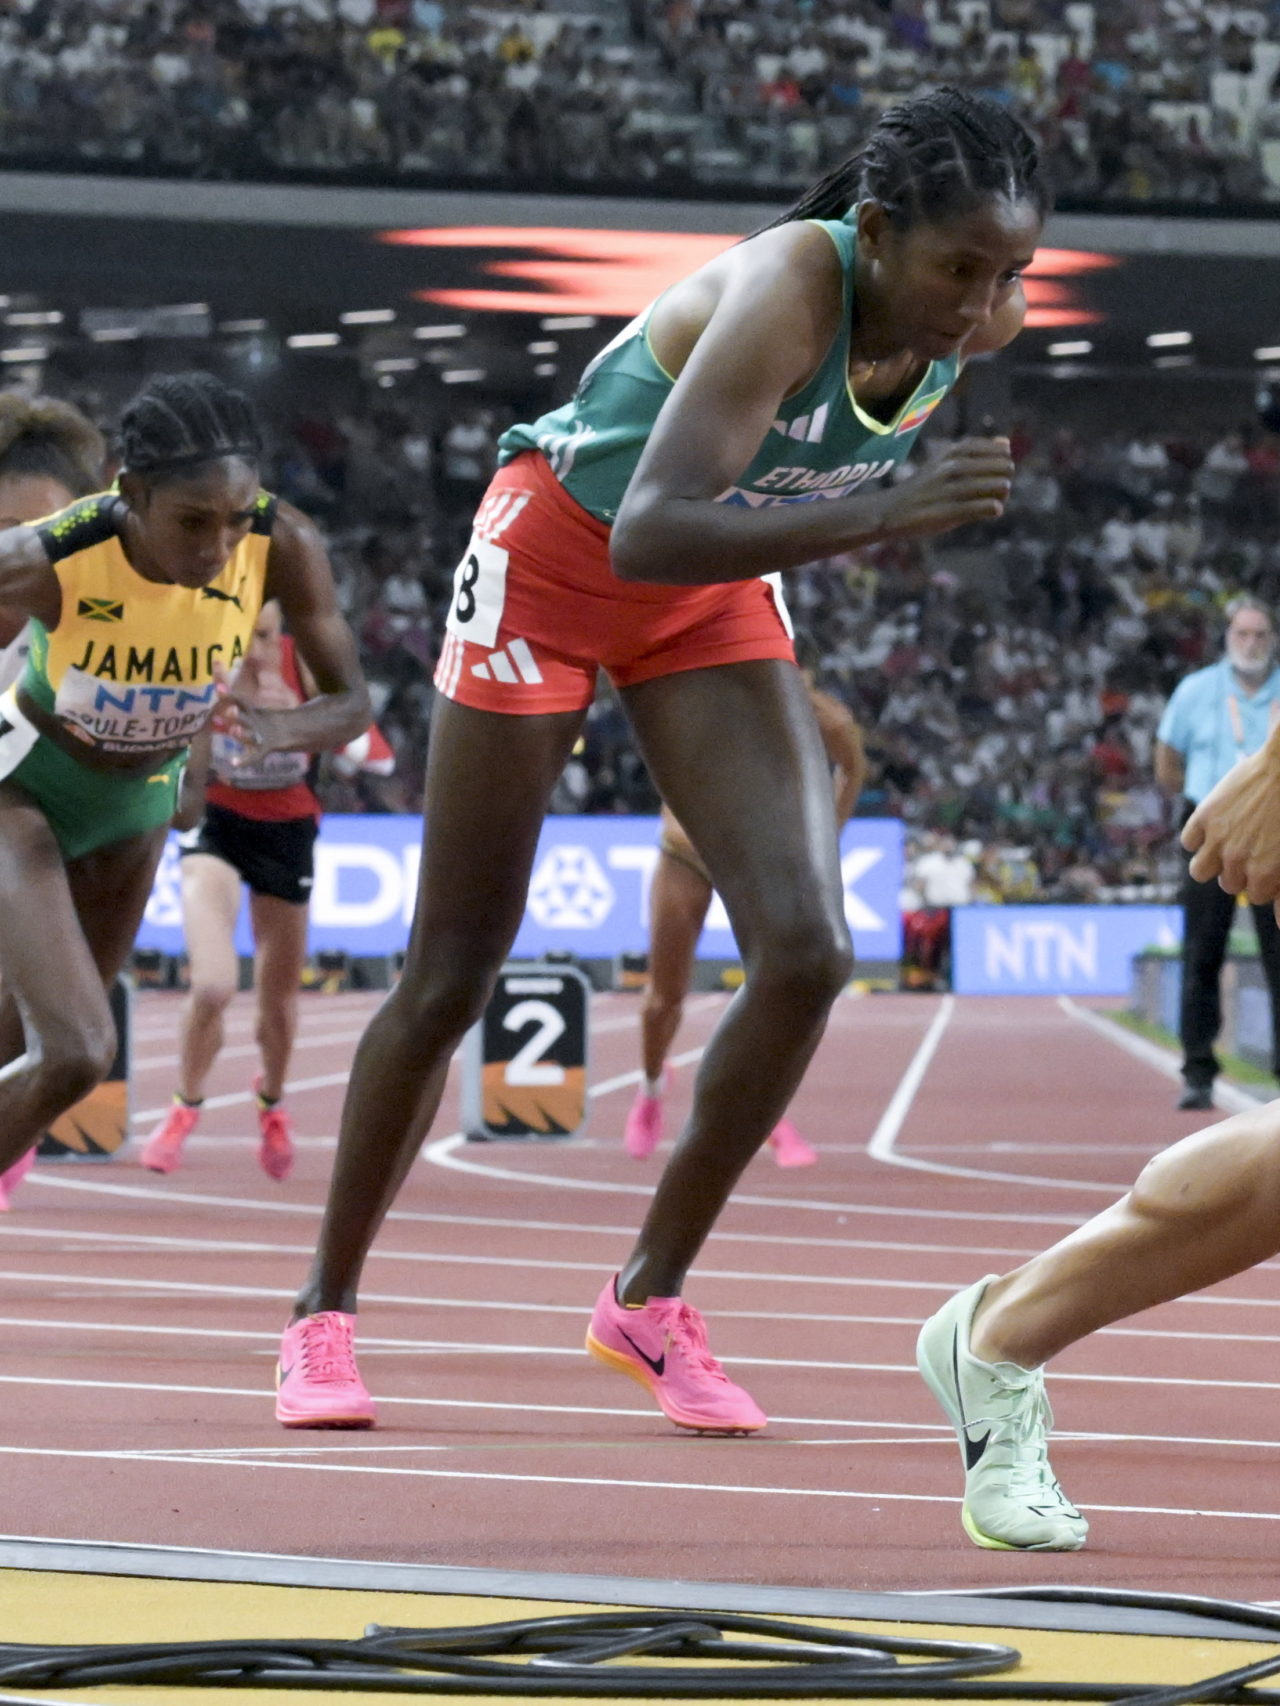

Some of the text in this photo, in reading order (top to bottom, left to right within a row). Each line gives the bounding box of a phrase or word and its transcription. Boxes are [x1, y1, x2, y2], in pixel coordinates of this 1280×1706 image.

[753, 459, 895, 489] ETHIOPIA
[455, 554, 479, 623] 8
[71, 635, 243, 682] JAMAICA
[94, 684, 216, 713] NTN
[984, 921, 1099, 982] NTN
[503, 1000, 566, 1086] 2
